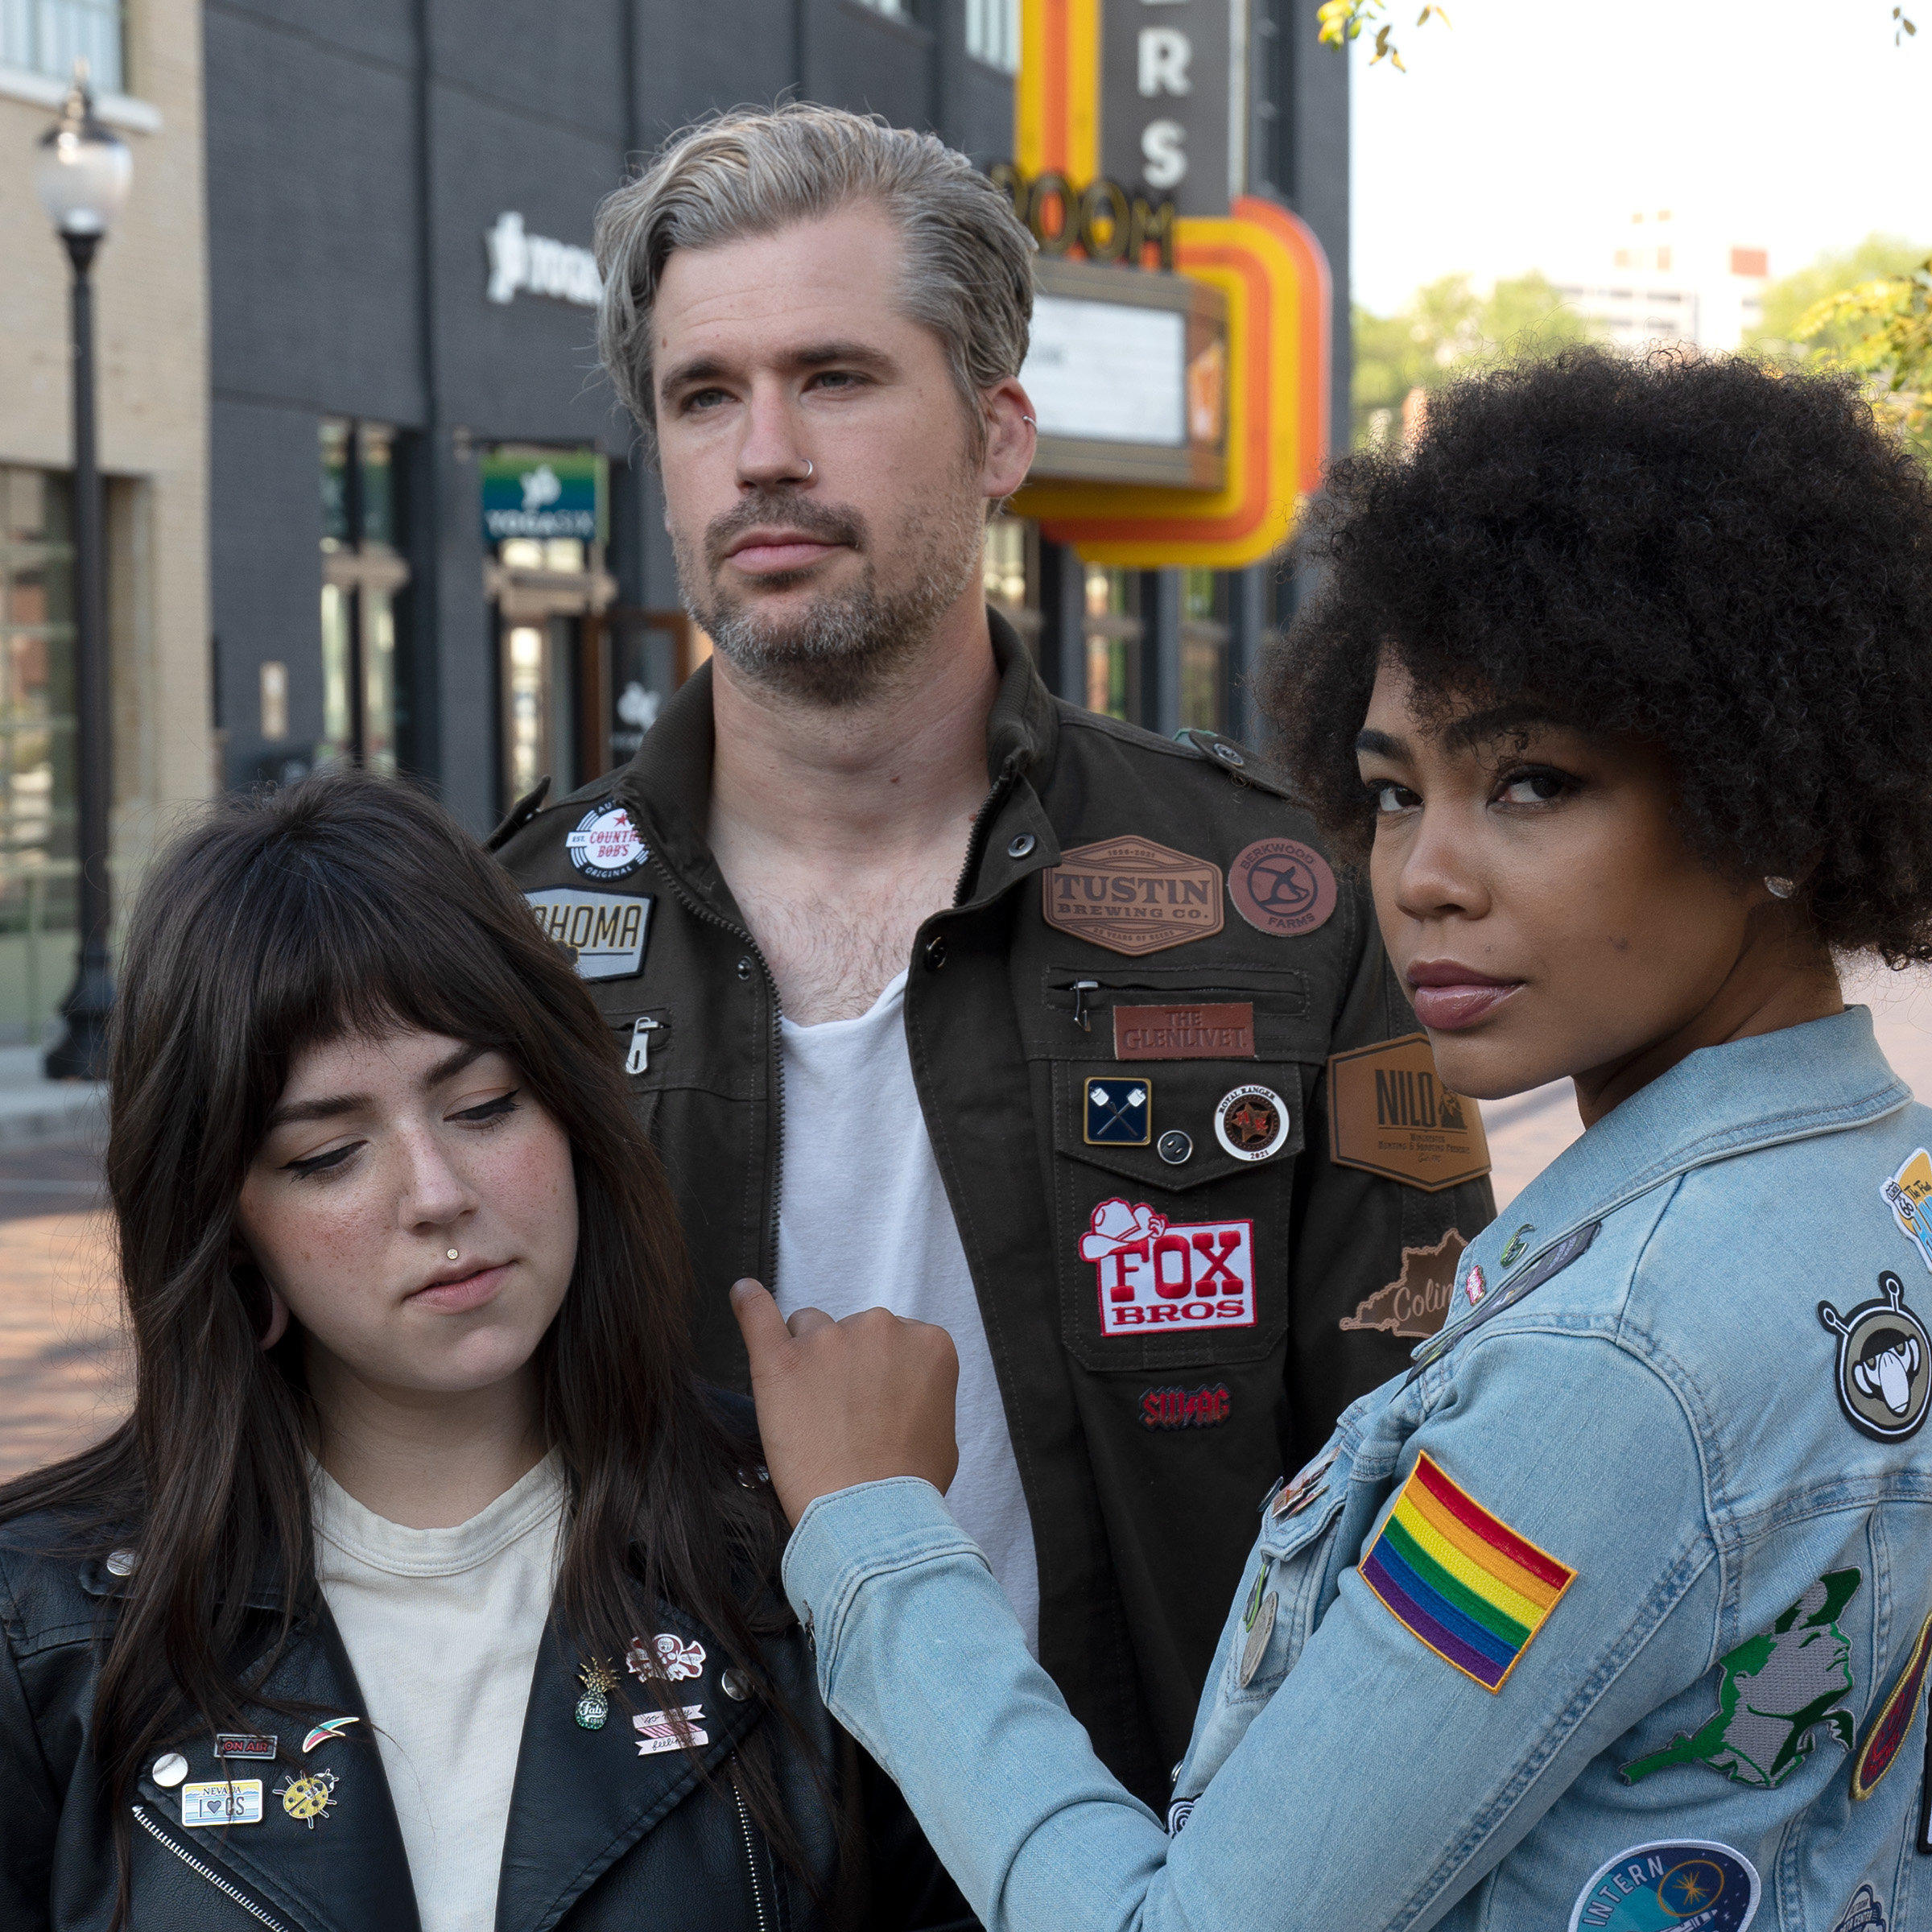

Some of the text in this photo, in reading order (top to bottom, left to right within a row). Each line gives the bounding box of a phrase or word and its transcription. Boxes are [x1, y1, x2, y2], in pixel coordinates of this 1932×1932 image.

[1137, 0, 1193, 191] RS
[589, 829, 642, 844] COUNTR
[597, 844, 630, 858] BOB'S
[1240, 843, 1315, 870] BERKWOOD
[584, 865, 633, 878] ORIGINAL
[1054, 873, 1212, 906] TUSTIN
[1056, 902, 1209, 919] BREWING CO.
[1268, 912, 1315, 929] FARMS
[1107, 930, 1134, 941] YEARS
[1165, 1010, 1203, 1027] THE
[1218, 1087, 1276, 1114] ROYAL RANGER
[1374, 1069, 1436, 1128] NILO
[1249, 1150, 1270, 1160] 2021
[1904, 1185, 1921, 1199] The
[1899, 1198, 1915, 1216] 66
[1109, 1229, 1245, 1303] FOX
[1112, 1299, 1245, 1326] BROS
[580, 1700, 604, 1716] Fab
[223, 1740, 269, 1753] ON AIR
[652, 1736, 696, 1752] feelin
[203, 1785, 242, 1796] NEVADA
[1582, 1855, 1666, 1927] INTERN
